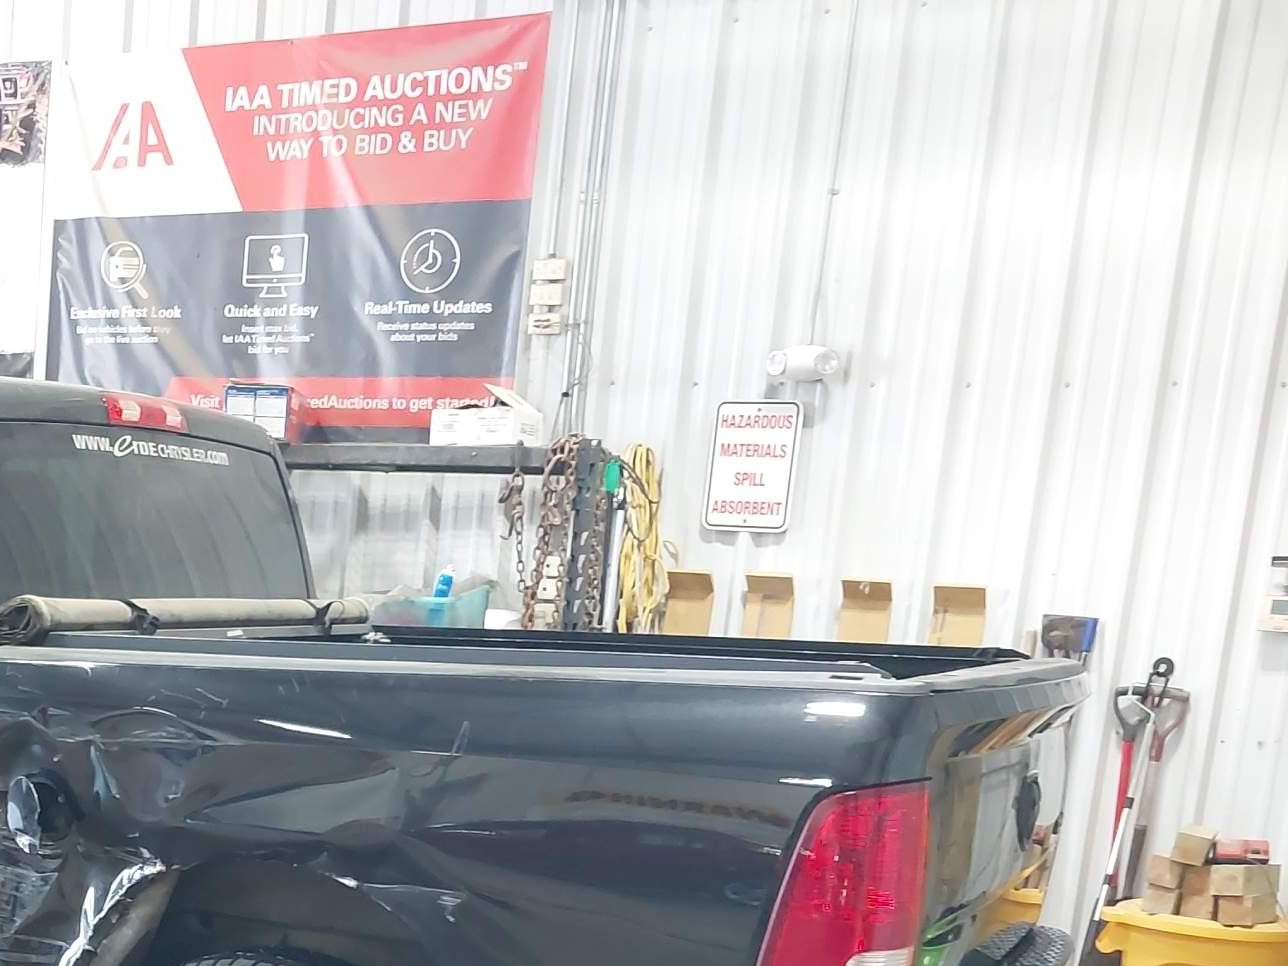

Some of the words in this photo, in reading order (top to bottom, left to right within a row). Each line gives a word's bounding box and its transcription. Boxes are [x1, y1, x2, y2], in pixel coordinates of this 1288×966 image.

[225, 84, 272, 111] IAA
[278, 77, 357, 108] TIMED
[253, 103, 404, 136] INTRODUCING
[410, 101, 428, 126] A
[435, 98, 493, 122] NEW
[267, 138, 313, 161] WAY
[319, 135, 347, 157] TO
[355, 132, 393, 155] BID
[397, 131, 417, 153] &
[424, 128, 473, 151] BUY
[121, 304, 149, 318] First
[151, 305, 182, 319] Look
[223, 304, 262, 318] Quick
[263, 304, 288, 317] and
[289, 303, 319, 319] Easy
[363, 300, 430, 315] Real-Time
[432, 300, 493, 316] Updates
[190, 394, 220, 410] Visit
[305, 395, 390, 411] edAuctions
[392, 396, 407, 410] to
[409, 397, 433, 413] get
[720, 414, 794, 429] HAZARDOUS
[719, 443, 788, 458] MATERIALS
[733, 472, 766, 486] SPILL
[711, 500, 783, 516] ABSORBENT
